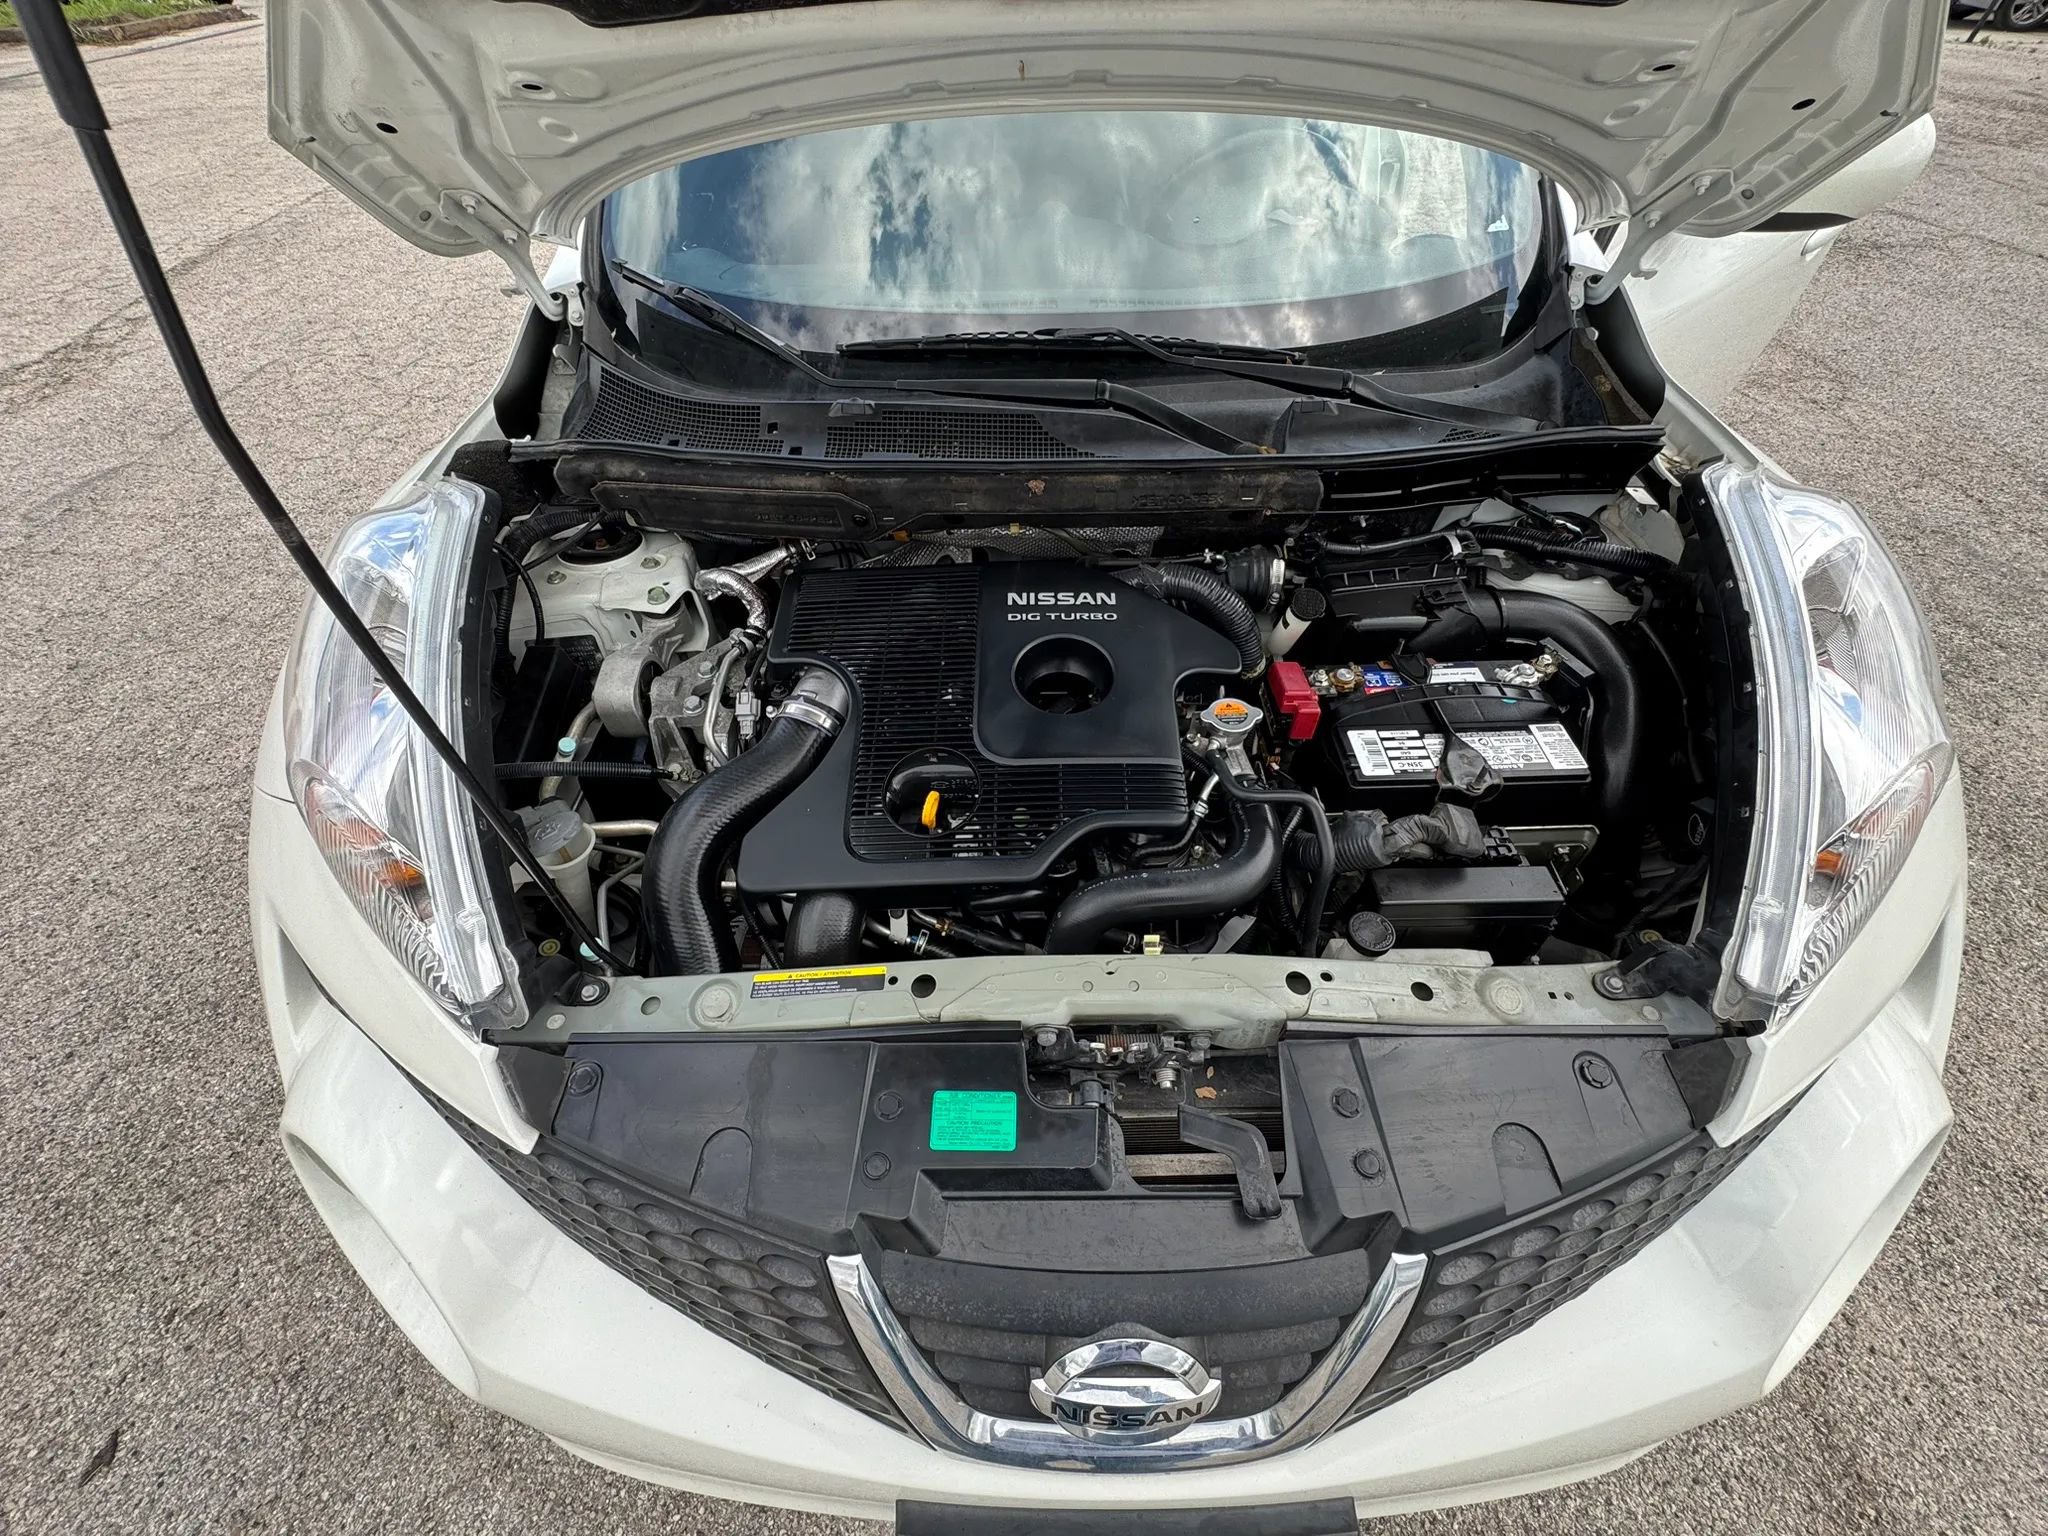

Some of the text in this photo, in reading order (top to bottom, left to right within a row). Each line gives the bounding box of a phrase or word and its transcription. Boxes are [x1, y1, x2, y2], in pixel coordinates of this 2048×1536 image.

[1007, 592, 1117, 606] NISSAN
[1007, 612, 1118, 621] DIG TURBO
[1051, 1402, 1203, 1427] NISSAN
